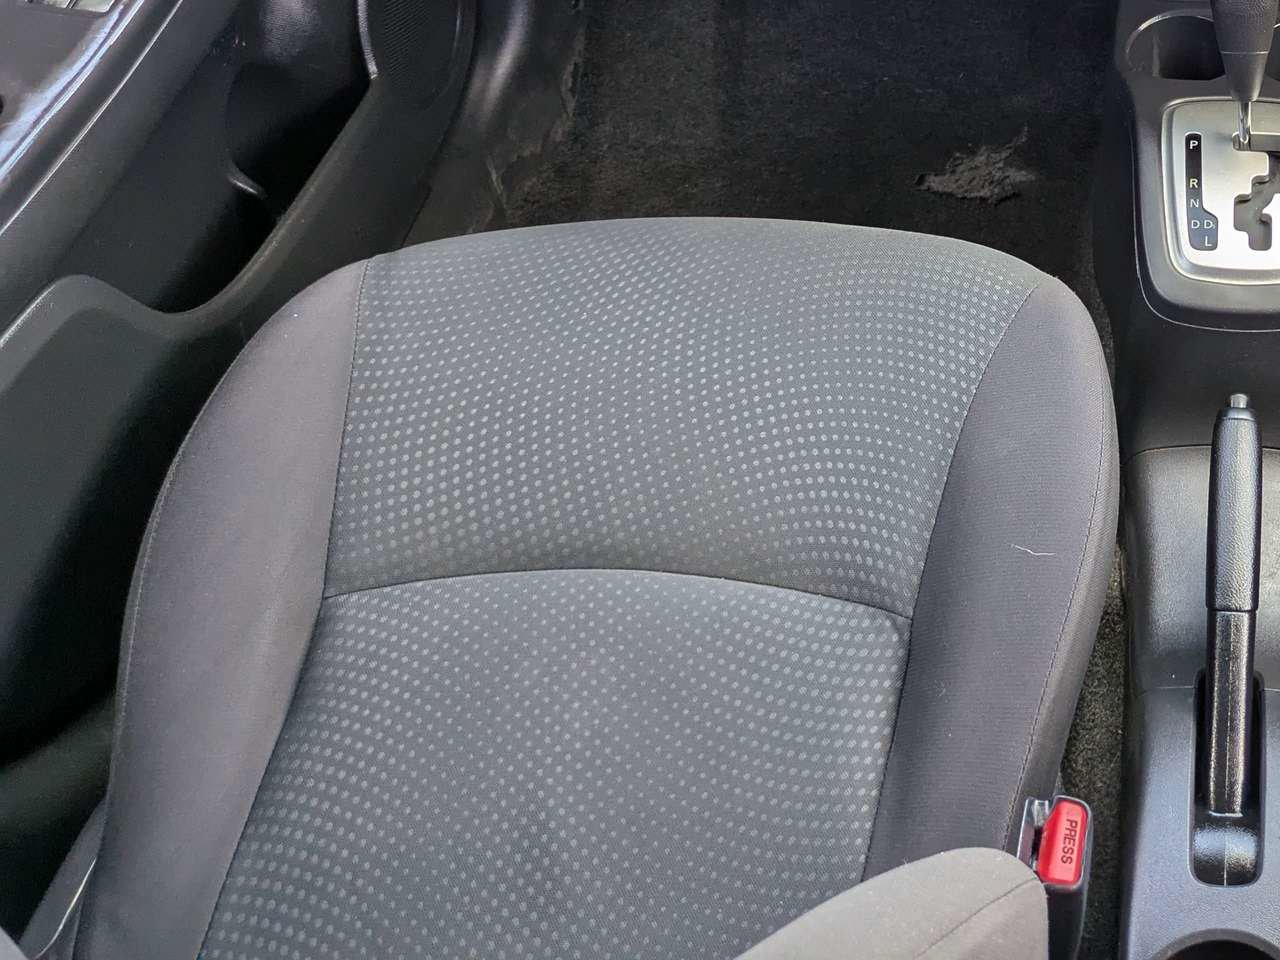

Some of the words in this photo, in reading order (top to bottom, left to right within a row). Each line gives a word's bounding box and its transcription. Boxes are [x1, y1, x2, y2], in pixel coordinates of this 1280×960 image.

[1189, 140, 1199, 150] P
[1189, 178, 1199, 189] R
[1190, 199, 1200, 208] N
[1191, 220, 1200, 229] D
[1204, 236, 1213, 247] L
[1061, 818, 1078, 865] PRESS
